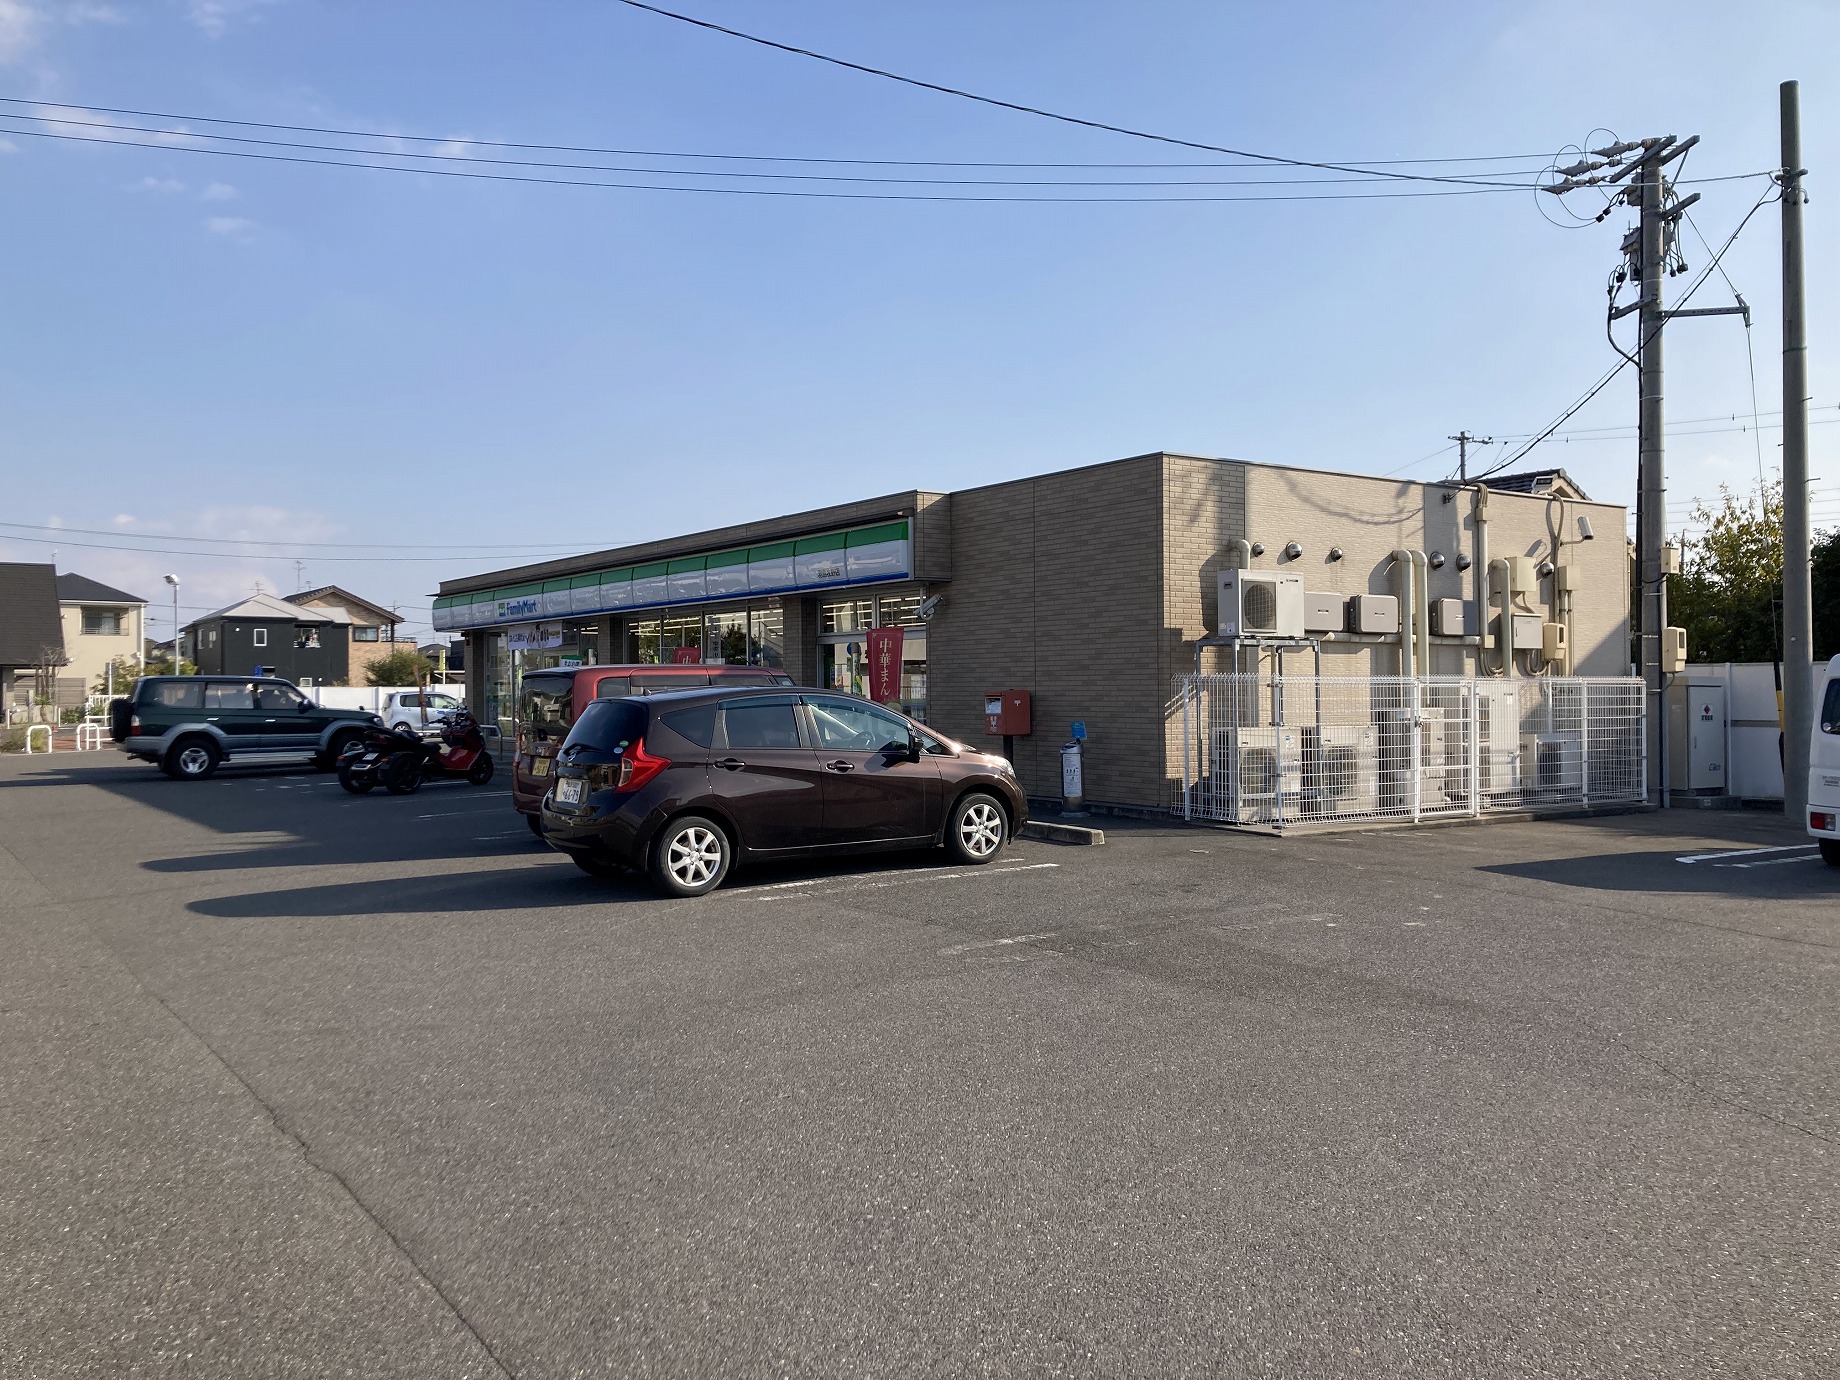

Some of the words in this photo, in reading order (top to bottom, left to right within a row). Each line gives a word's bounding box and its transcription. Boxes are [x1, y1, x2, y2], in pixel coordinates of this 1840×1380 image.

[506, 599, 537, 616] FamilyMart
[879, 637, 893, 696] 中華まん
